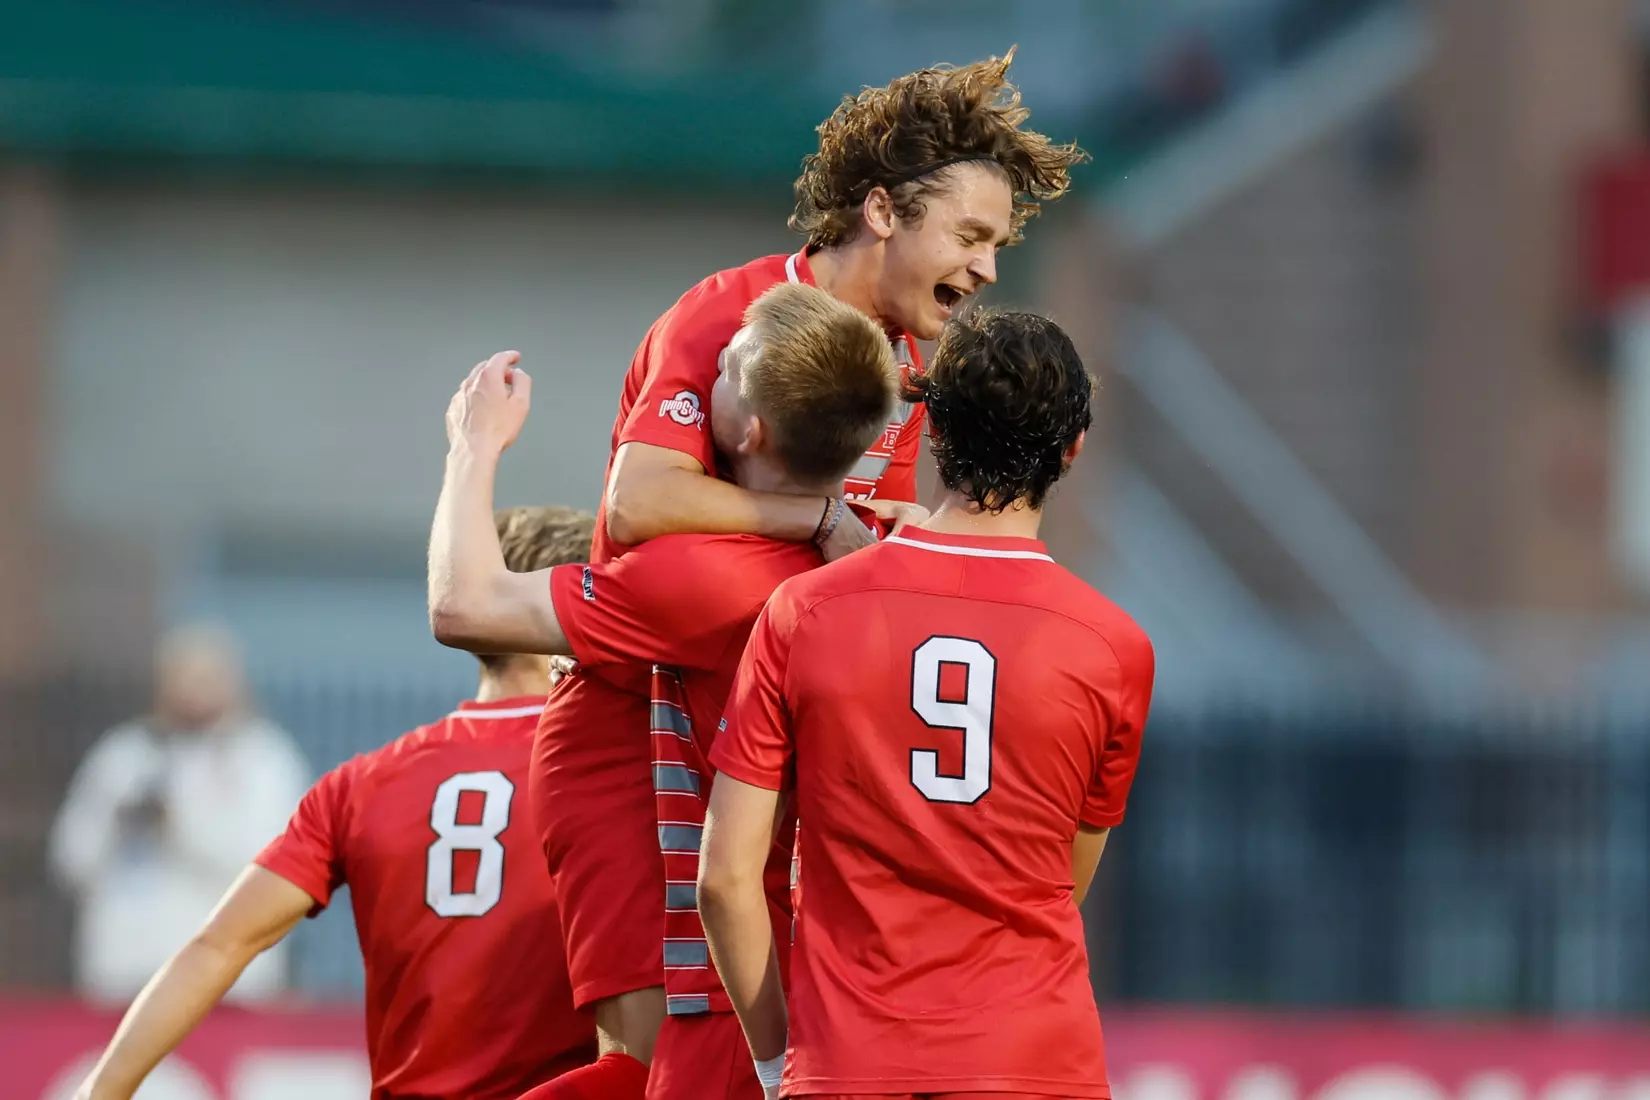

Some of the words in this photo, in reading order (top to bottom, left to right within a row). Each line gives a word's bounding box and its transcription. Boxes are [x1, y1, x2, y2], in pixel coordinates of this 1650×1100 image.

[658, 399, 683, 418] OHIO
[679, 400, 706, 432] STATE
[909, 634, 998, 806] 9
[424, 769, 516, 919] 8
